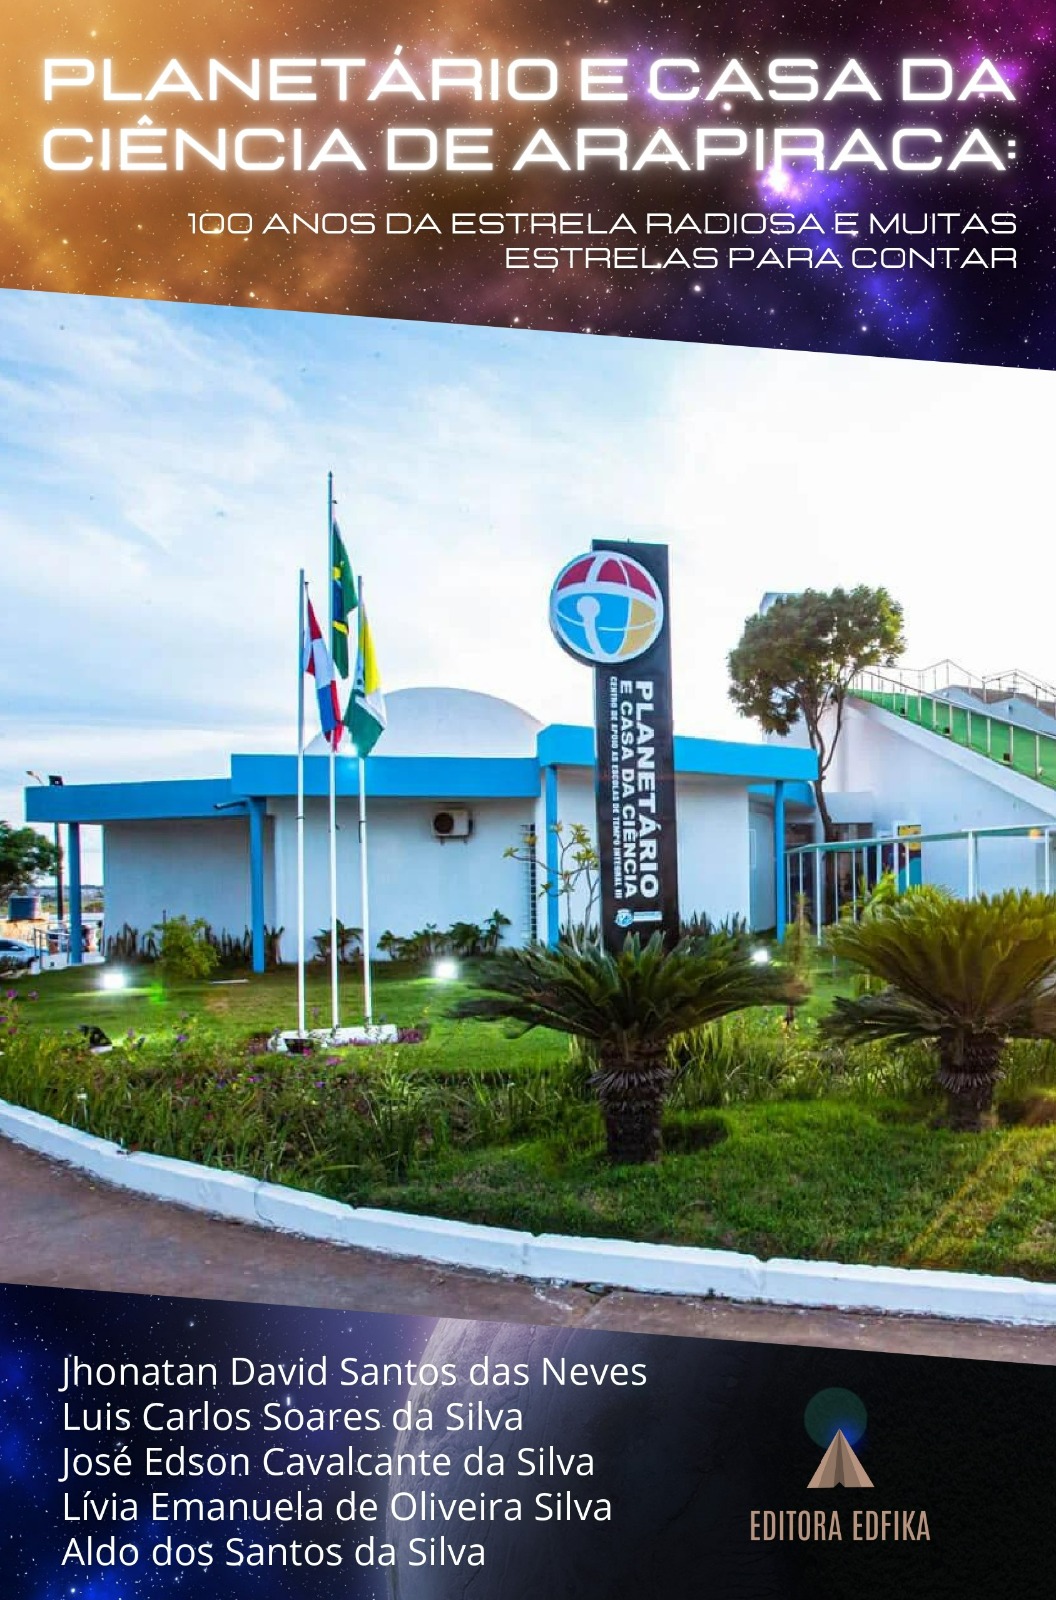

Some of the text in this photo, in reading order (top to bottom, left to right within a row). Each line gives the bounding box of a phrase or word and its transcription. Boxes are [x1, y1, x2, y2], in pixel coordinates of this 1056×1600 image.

[620, 680, 639, 898] E CASA DA CIÊNCIA
[635, 680, 662, 898] PLANETÁRIO
